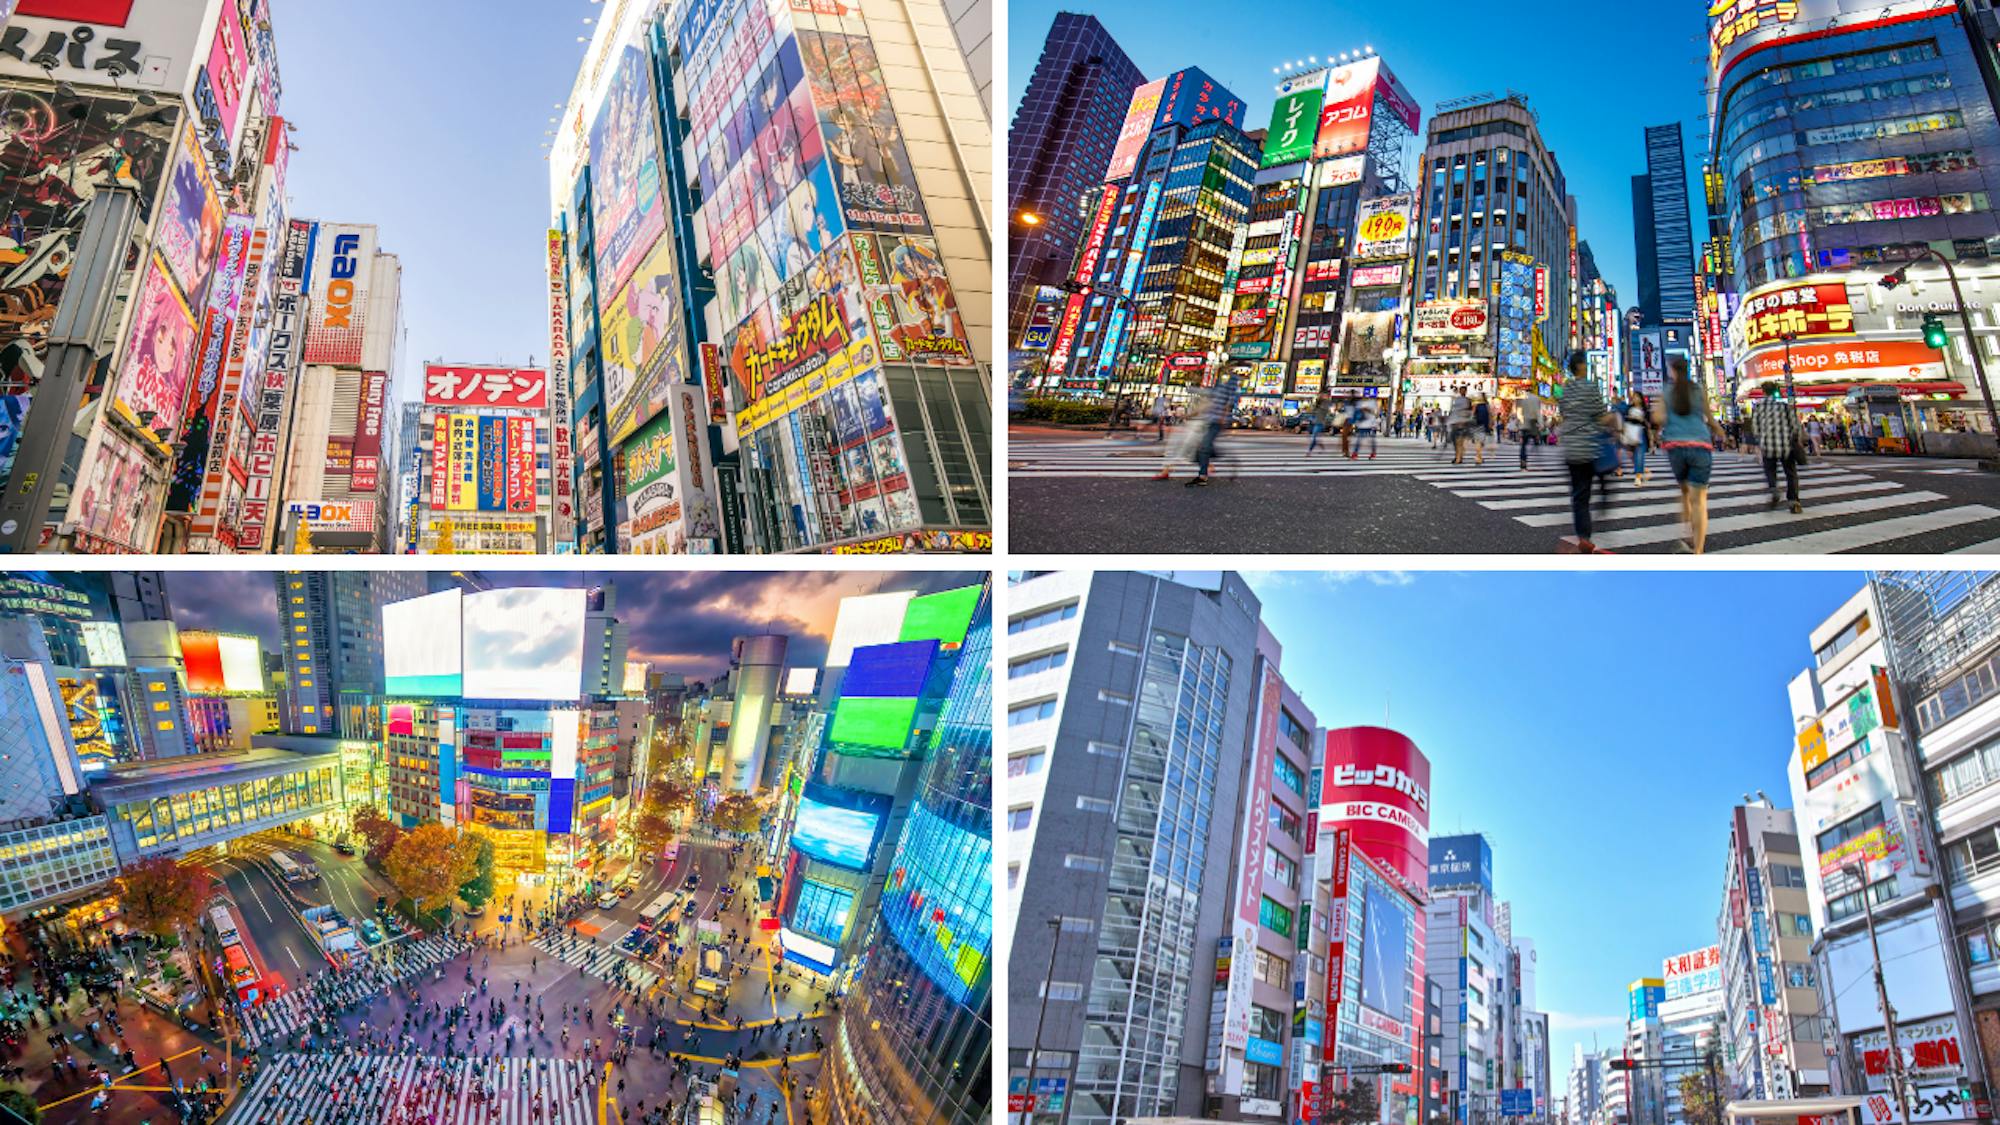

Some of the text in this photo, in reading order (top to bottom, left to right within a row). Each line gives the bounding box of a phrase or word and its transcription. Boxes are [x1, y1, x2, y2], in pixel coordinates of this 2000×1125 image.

[1281, 98, 1304, 148] レイク
[1324, 105, 1369, 127] アコム
[1896, 302, 1924, 313] Don
[553, 296, 564, 357] TAKARADA
[1027, 330, 1049, 343] GU
[1295, 329, 1331, 342] アコム
[745, 291, 850, 401] カードキングダム
[1763, 359, 1786, 372] Free
[1789, 352, 1829, 369] Shop
[1834, 352, 1881, 364] 免税店
[428, 370, 544, 403] オノデン
[366, 375, 386, 436] Duty Free
[434, 444, 446, 468] TAX
[432, 471, 445, 505] FREE
[1333, 763, 1428, 812] ビックカメラ
[1346, 804, 1421, 835] BIC CAMERA
[1665, 947, 1720, 977] 大和証券
